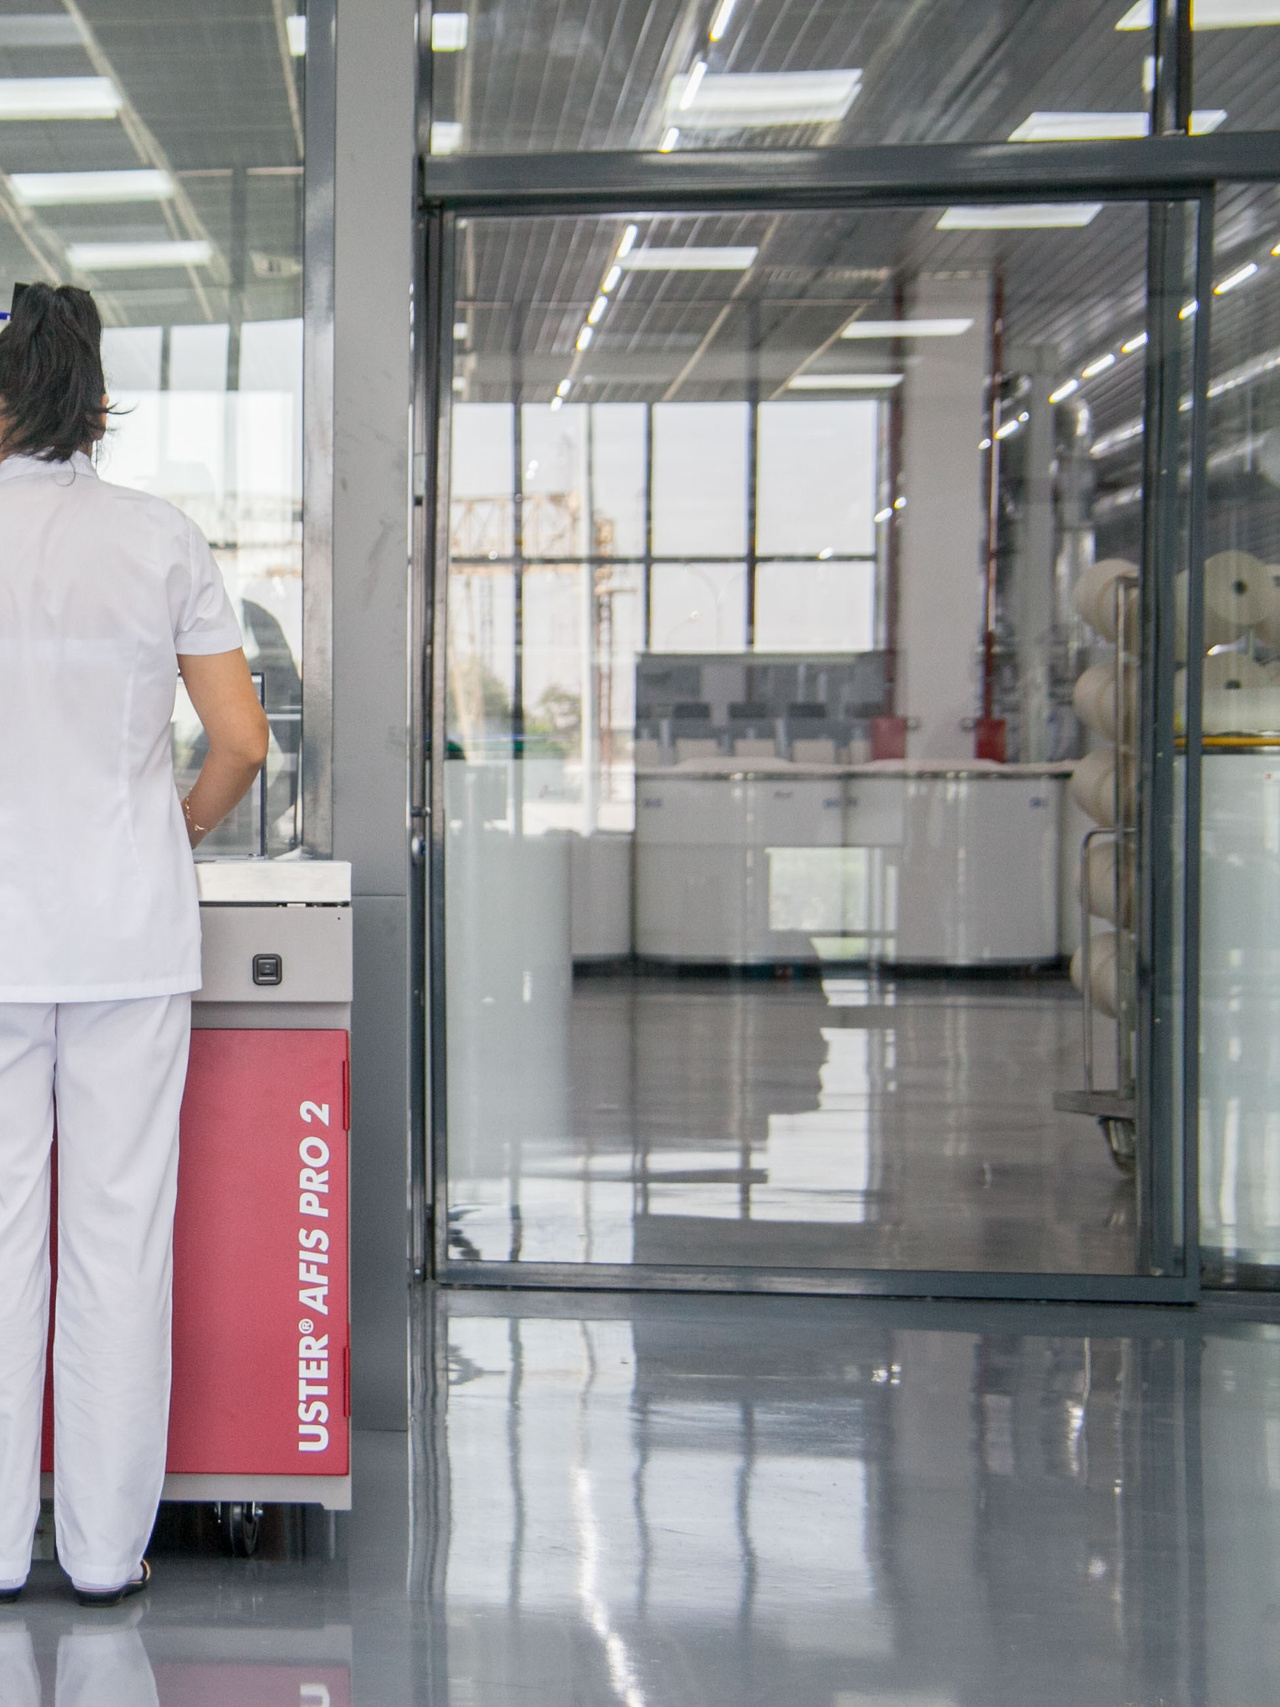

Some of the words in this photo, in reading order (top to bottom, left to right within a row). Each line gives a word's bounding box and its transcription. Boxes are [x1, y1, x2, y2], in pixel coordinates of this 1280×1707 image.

[299, 1100, 329, 1127] 2
[299, 1136, 329, 1218] PRO
[299, 1228, 329, 1315] AFIS
